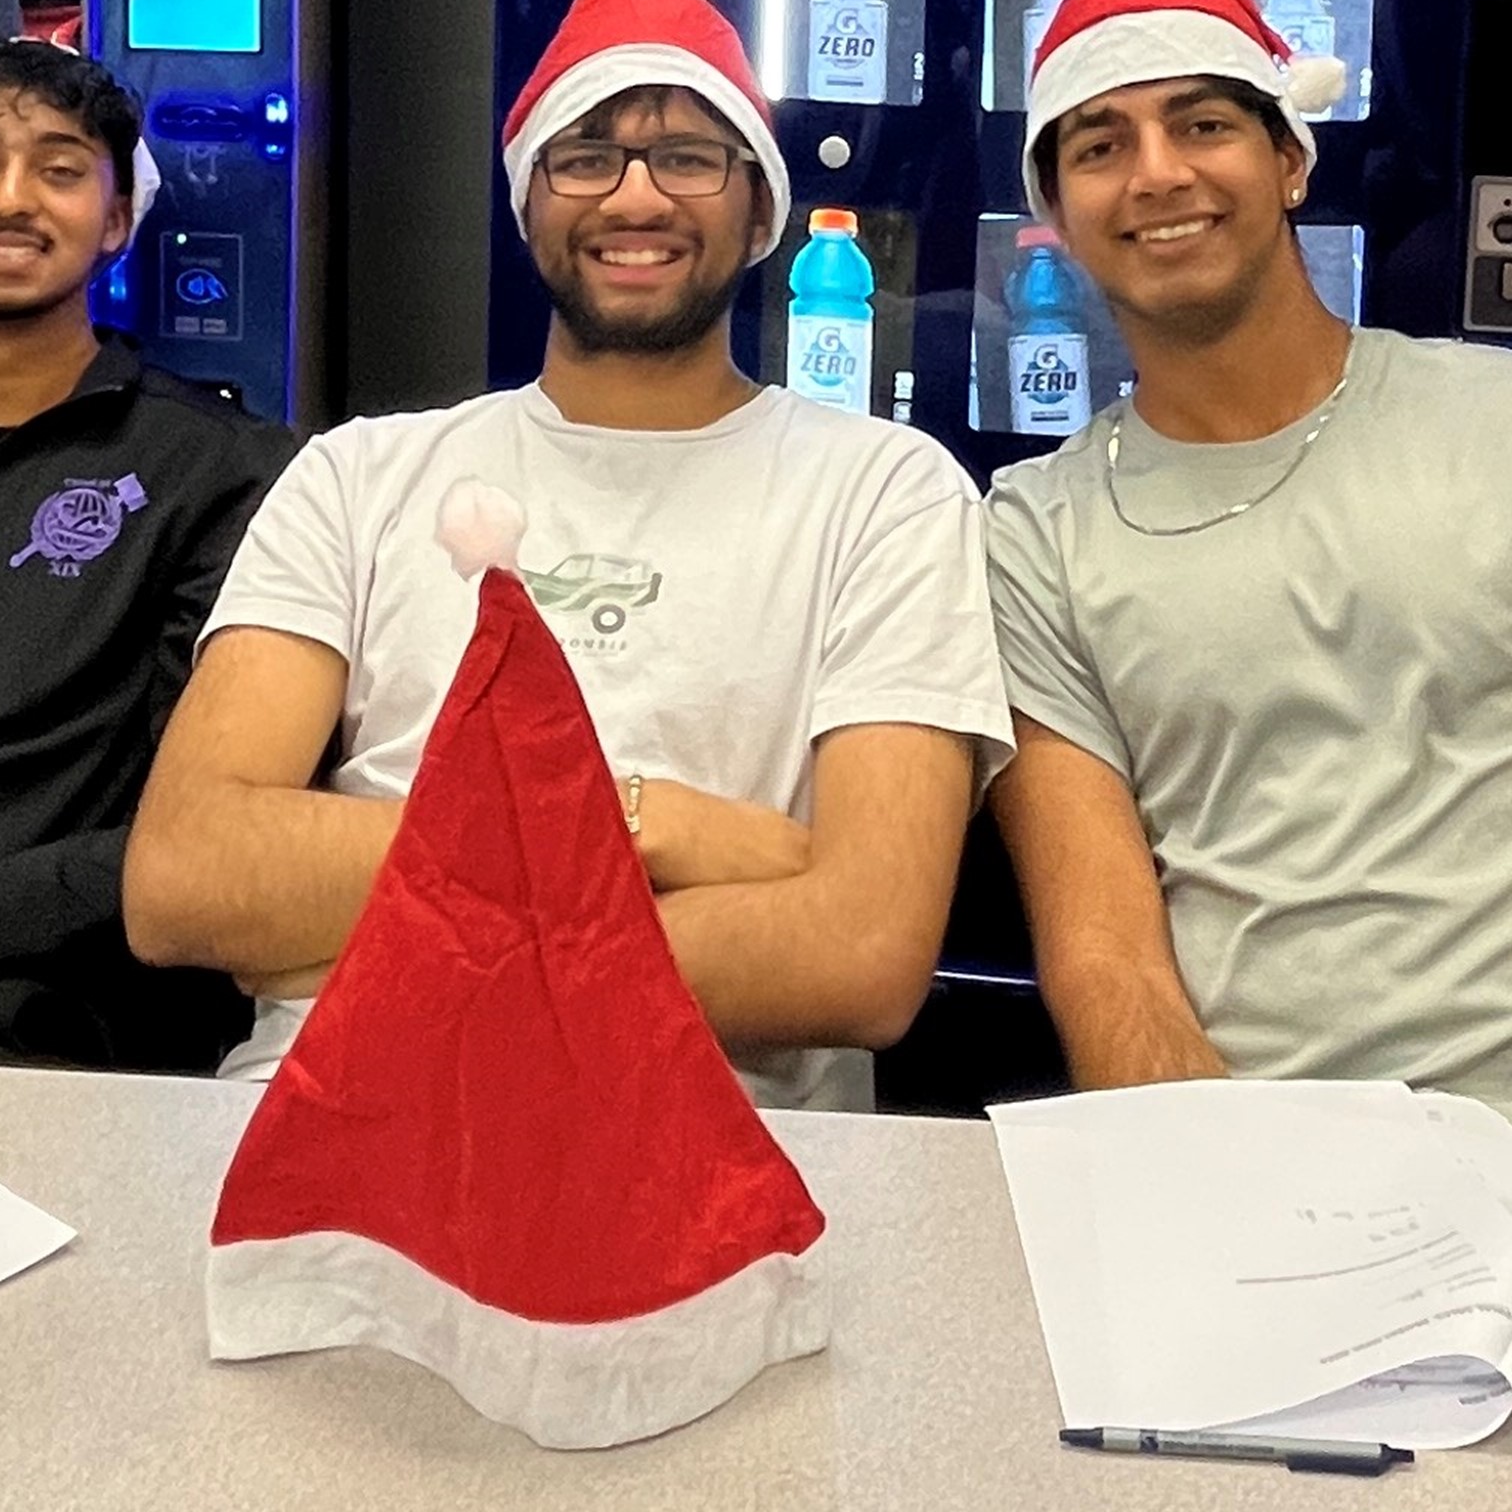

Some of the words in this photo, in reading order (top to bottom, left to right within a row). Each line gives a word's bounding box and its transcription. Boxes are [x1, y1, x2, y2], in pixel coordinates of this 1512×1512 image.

[817, 36, 876, 57] ZERO
[799, 351, 857, 375] ZERO
[1018, 370, 1078, 394] ZERO
